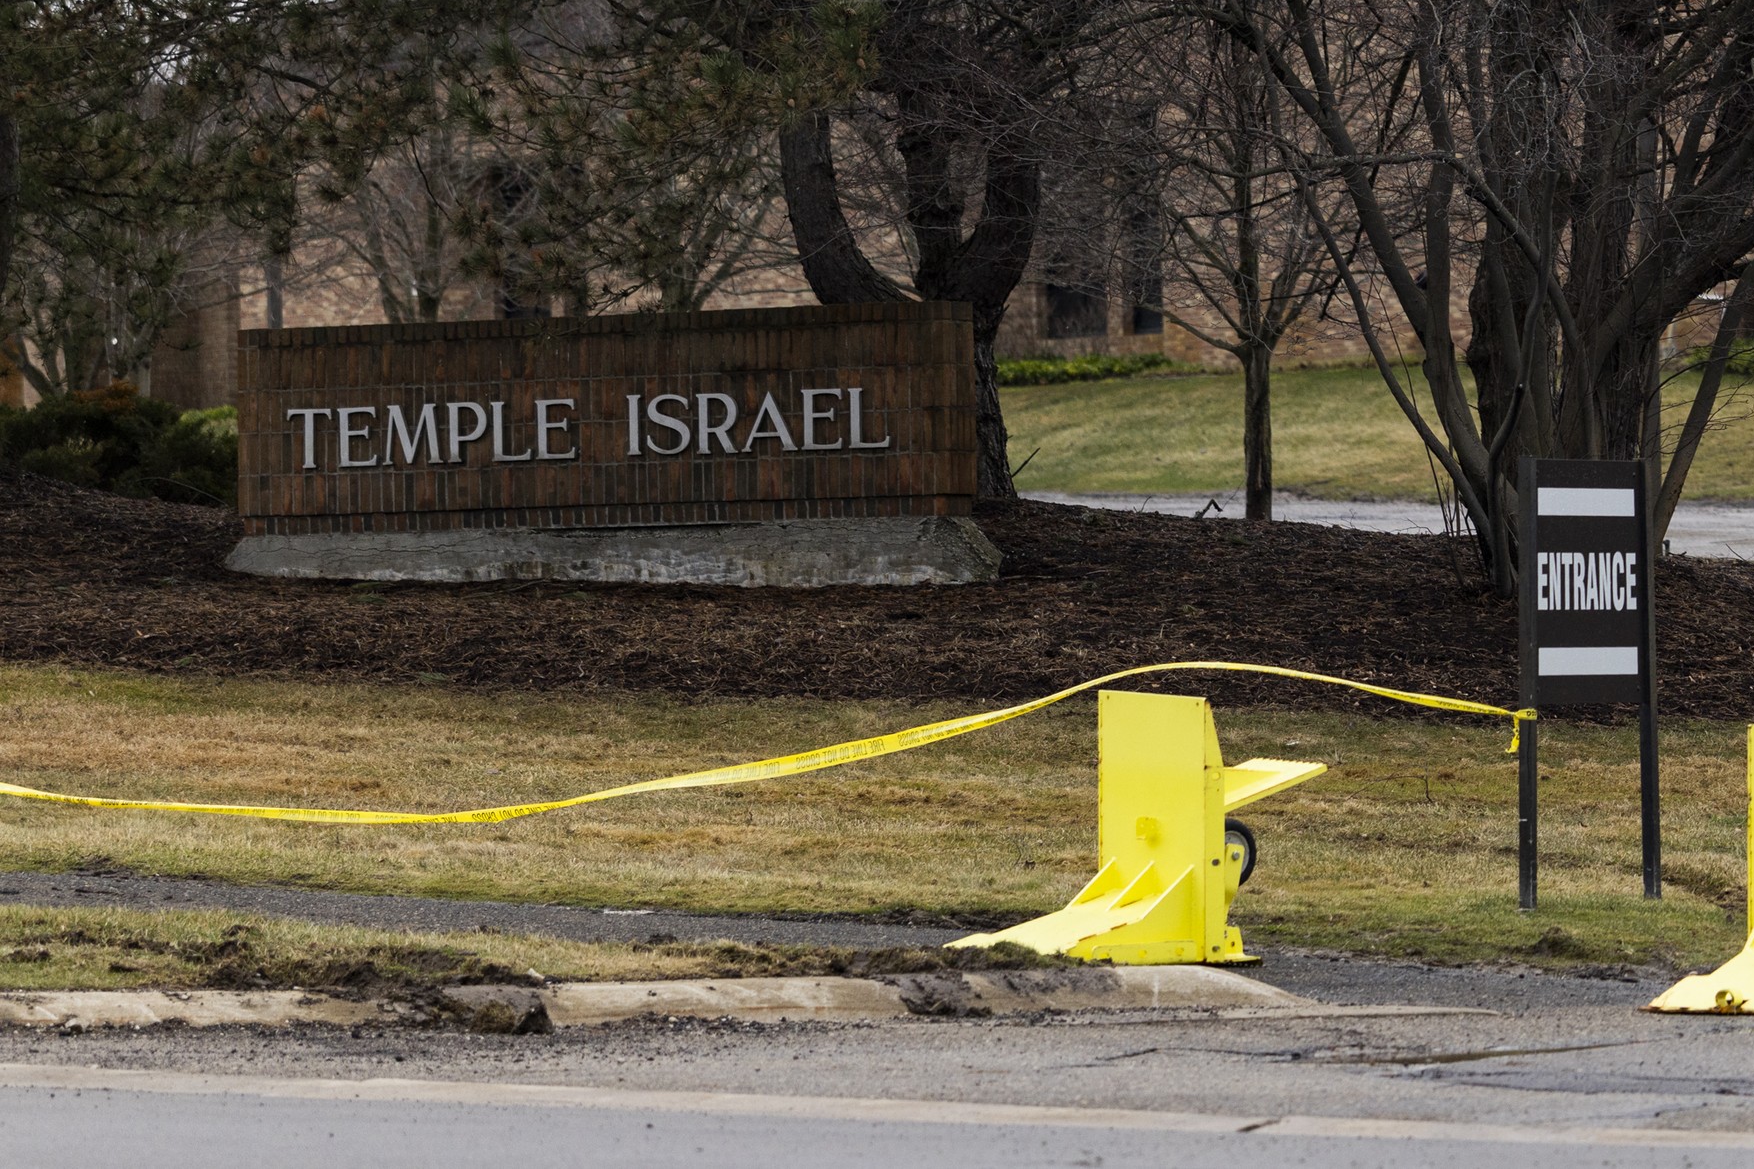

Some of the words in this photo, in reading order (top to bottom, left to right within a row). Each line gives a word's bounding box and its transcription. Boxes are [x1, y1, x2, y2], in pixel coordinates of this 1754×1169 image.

[286, 398, 579, 470] TEMPLE
[625, 387, 892, 457] ISRAEL
[1537, 551, 1637, 612] ENTRANCE
